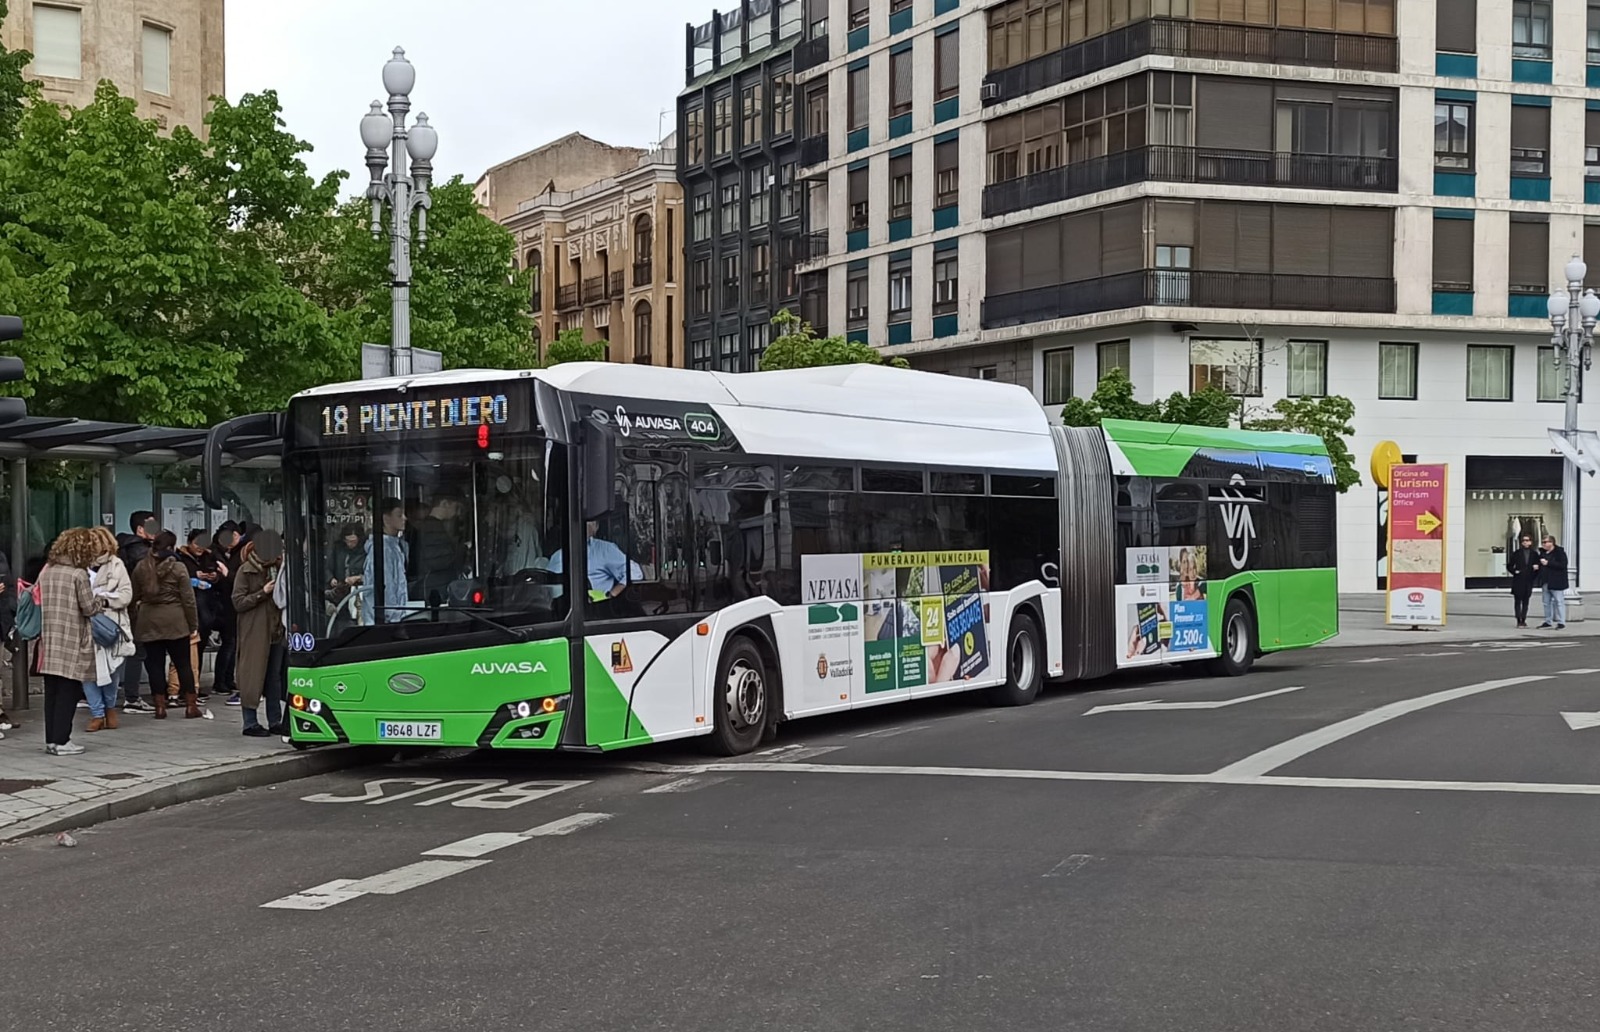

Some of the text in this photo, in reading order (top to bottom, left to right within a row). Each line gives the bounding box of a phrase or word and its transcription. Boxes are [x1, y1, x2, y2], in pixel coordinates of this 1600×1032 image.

[322, 394, 508, 436] 18 PUENTE DUERO
[635, 416, 681, 430] AUVASA
[690, 420, 715, 433] 404
[1394, 478, 1439, 488] Turismo
[1394, 490, 1429, 498] Tourism
[356, 498, 362, 506] 4
[871, 553, 983, 566] FUNERARIA MUNICIPAL
[808, 578, 860, 601] NEVASA
[926, 606, 939, 627] 24
[470, 661, 548, 674] AUVASA
[830, 666, 854, 678] Valladolid
[292, 678, 314, 688] 404
[386, 724, 438, 736] 9648 LZF
[300, 778, 595, 809] BUS
